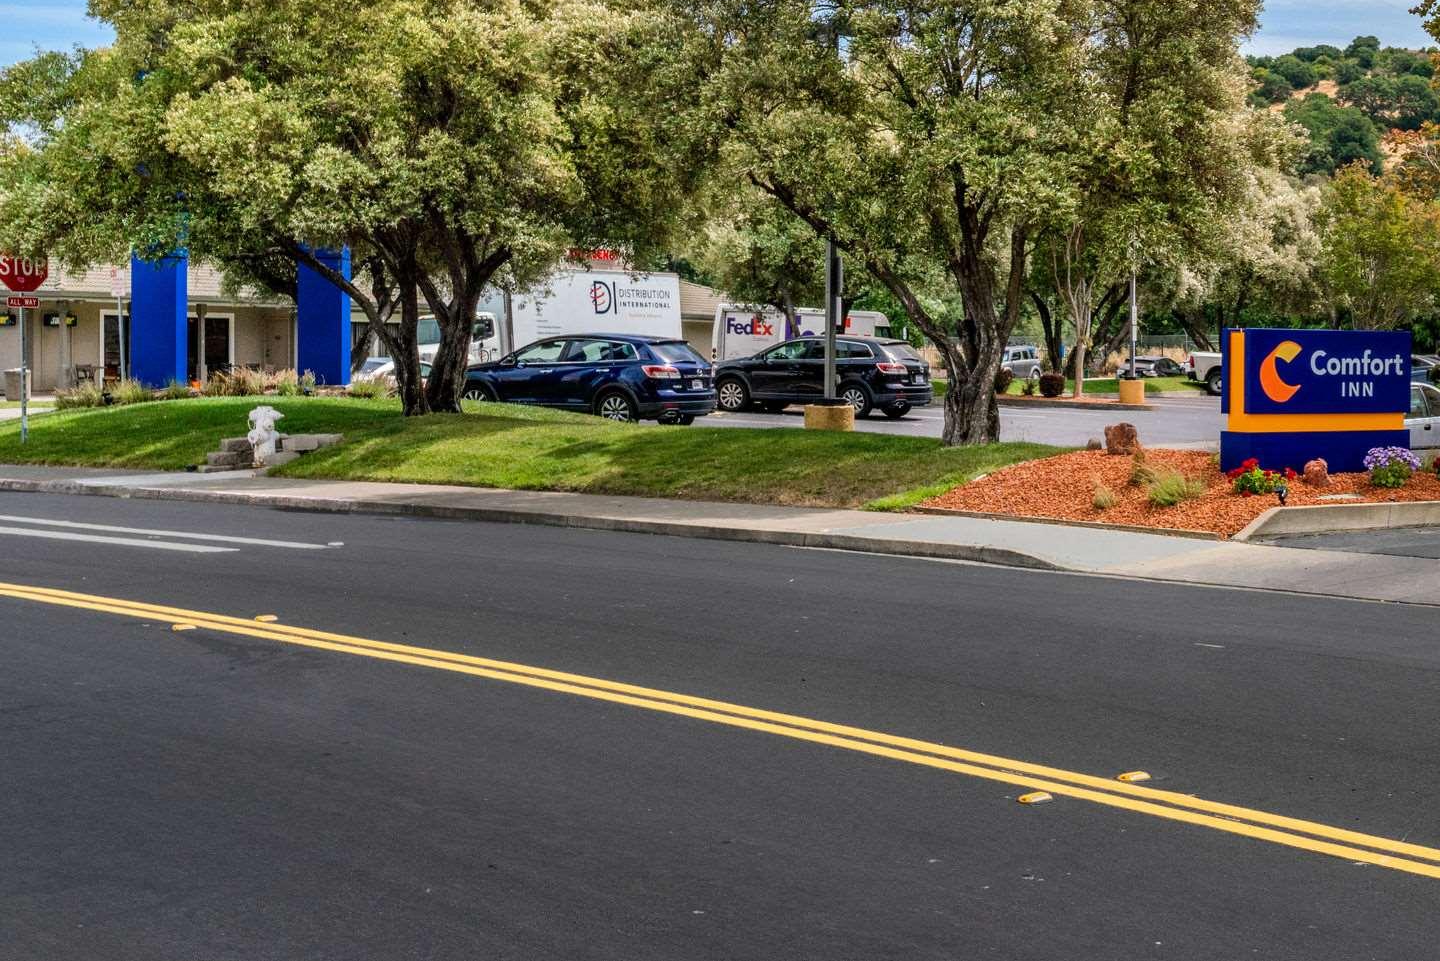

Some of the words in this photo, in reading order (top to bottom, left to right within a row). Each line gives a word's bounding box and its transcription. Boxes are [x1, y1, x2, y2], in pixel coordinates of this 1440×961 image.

[618, 288, 671, 300] DISTRIBUTION
[619, 301, 672, 309] INTERNATIONAL
[726, 315, 774, 336] FedEx
[1310, 349, 1403, 376] Comfort
[1341, 381, 1374, 397] INN
